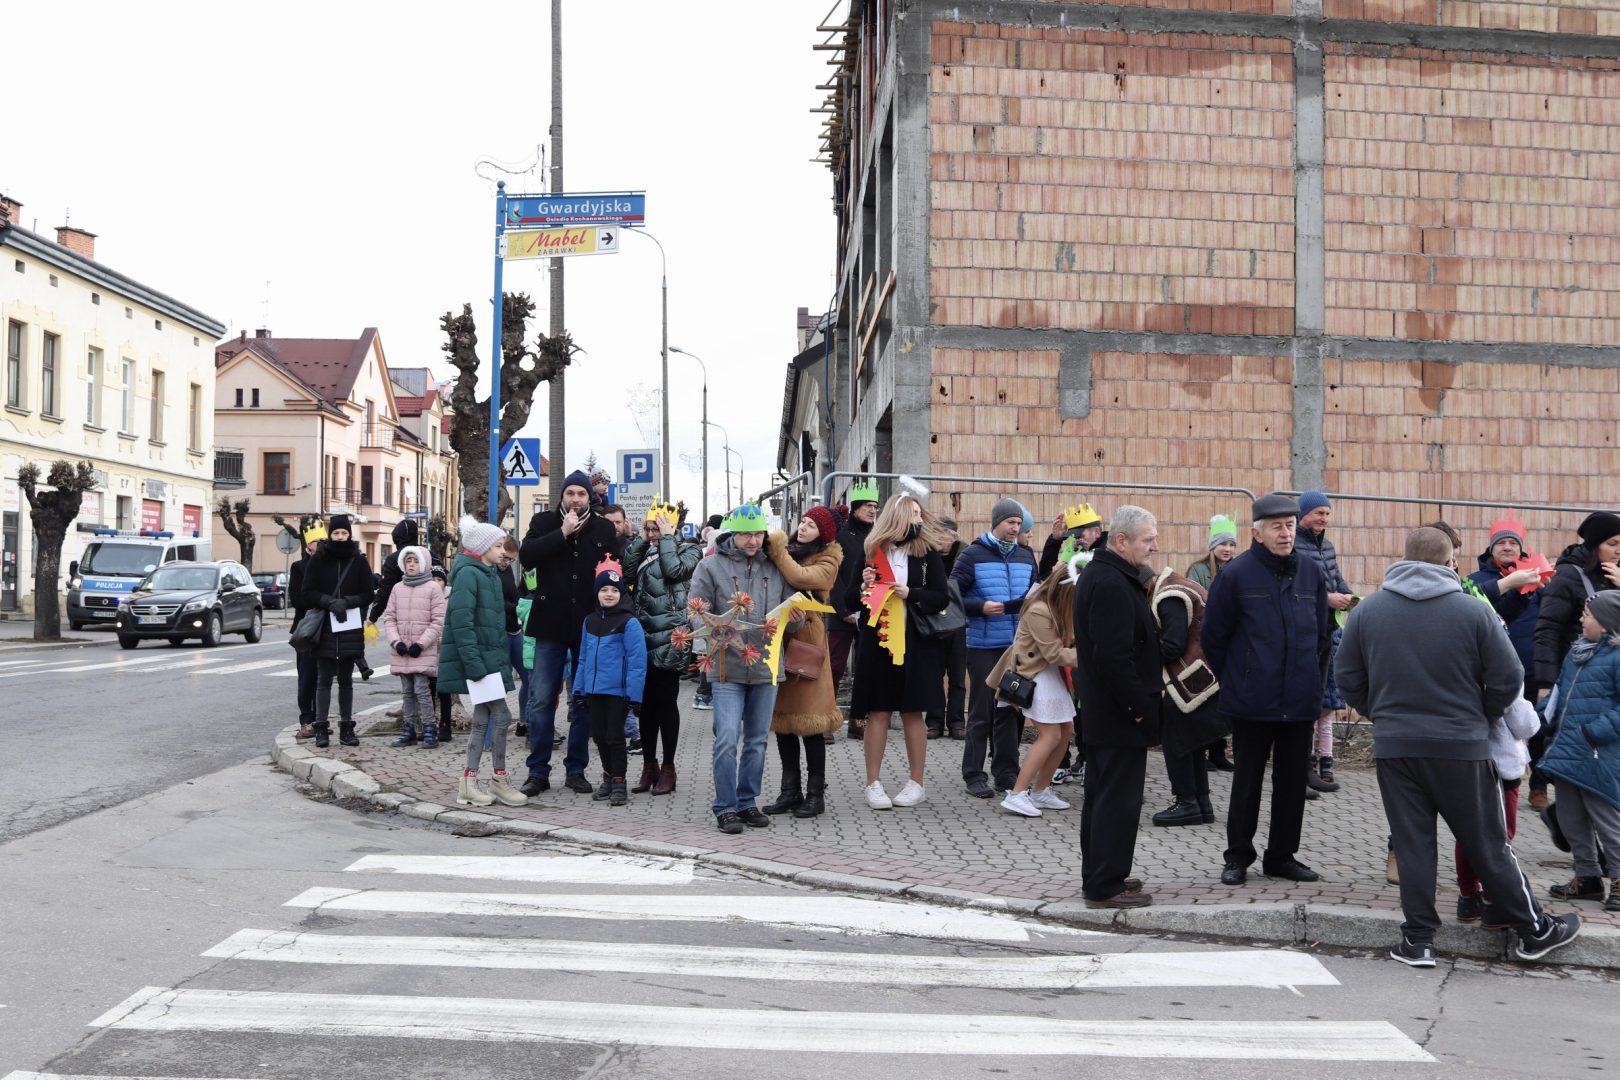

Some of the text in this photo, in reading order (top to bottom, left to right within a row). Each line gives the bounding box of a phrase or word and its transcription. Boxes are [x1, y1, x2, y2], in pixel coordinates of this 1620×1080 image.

[538, 199, 632, 216] Gwardyjska
[526, 228, 587, 253] Mabel
[537, 247, 577, 255] ZABAWKI
[630, 457, 648, 480] P
